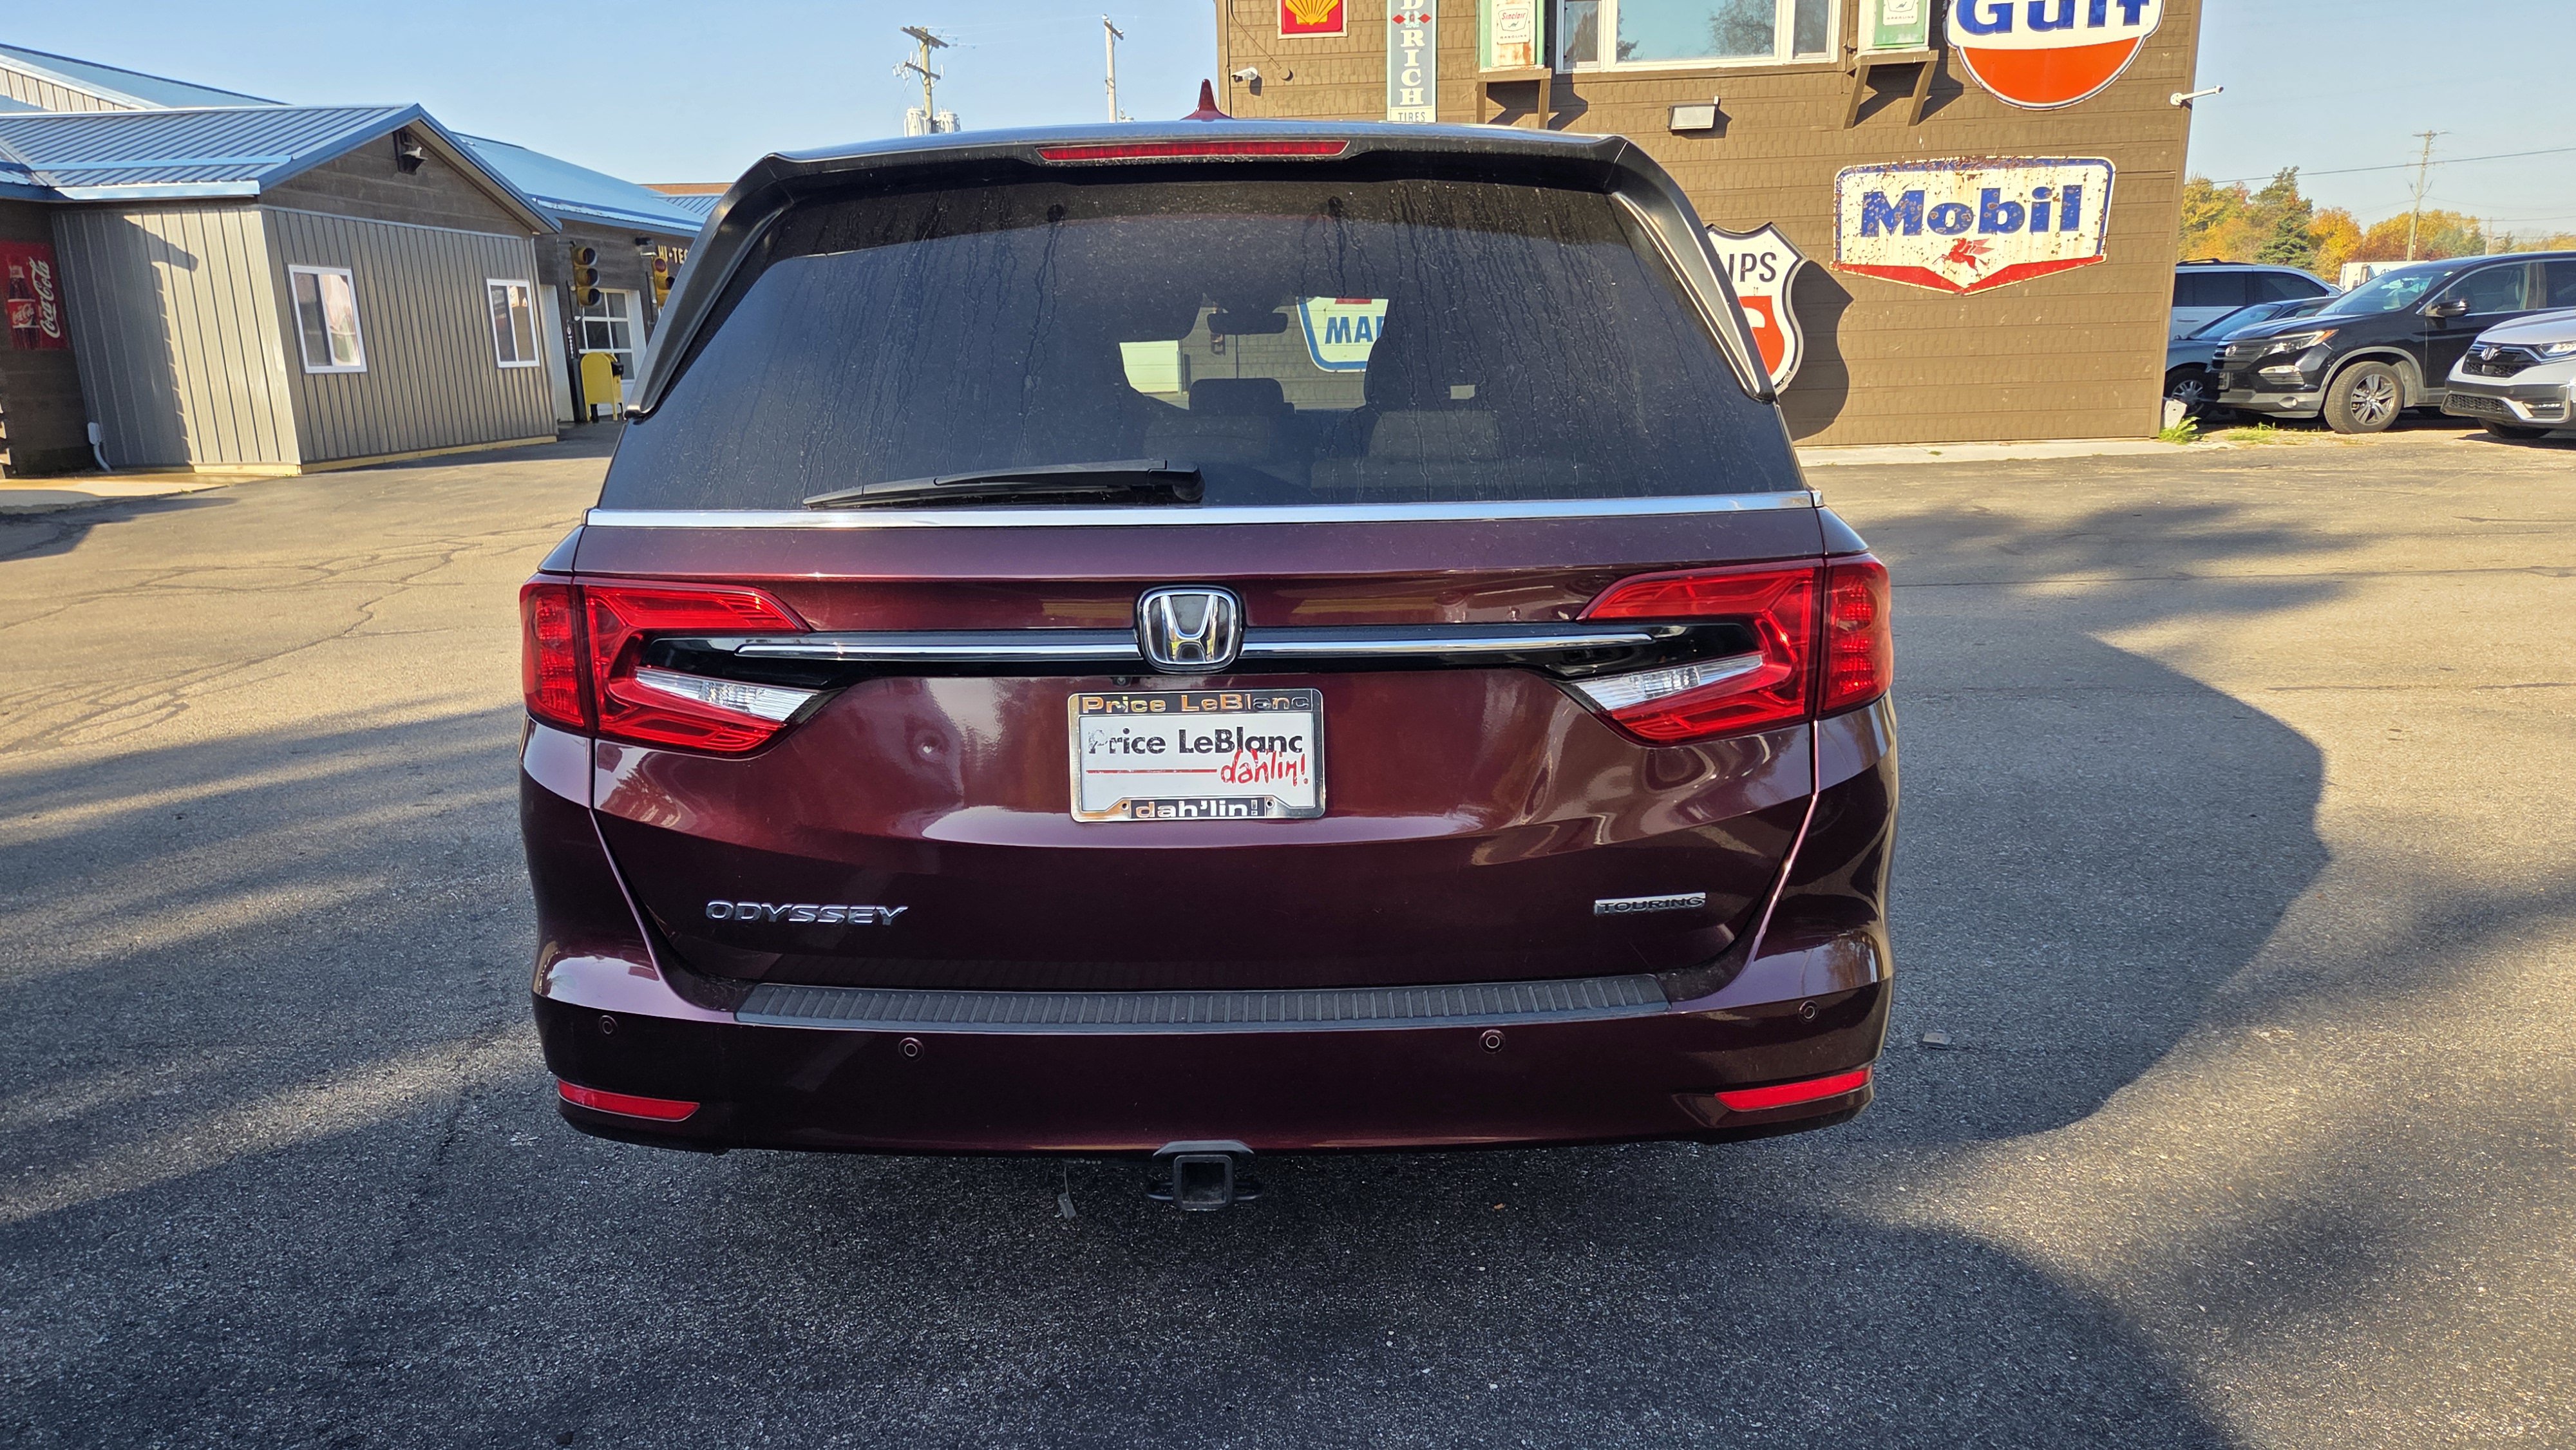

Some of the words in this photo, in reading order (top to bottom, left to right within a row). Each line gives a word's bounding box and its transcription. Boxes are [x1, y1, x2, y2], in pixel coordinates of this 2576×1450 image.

[1502, 11, 1526, 20] Sinclair
[1398, 111, 1425, 122] TIRES
[1861, 185, 2083, 238] Mobil
[1082, 695, 1166, 713] Price
[1181, 693, 1310, 712] LeBlanc
[1179, 726, 1303, 753] LeBlanc
[705, 899, 909, 926] ODYSSEY
[1600, 896, 1706, 914] TOURING
